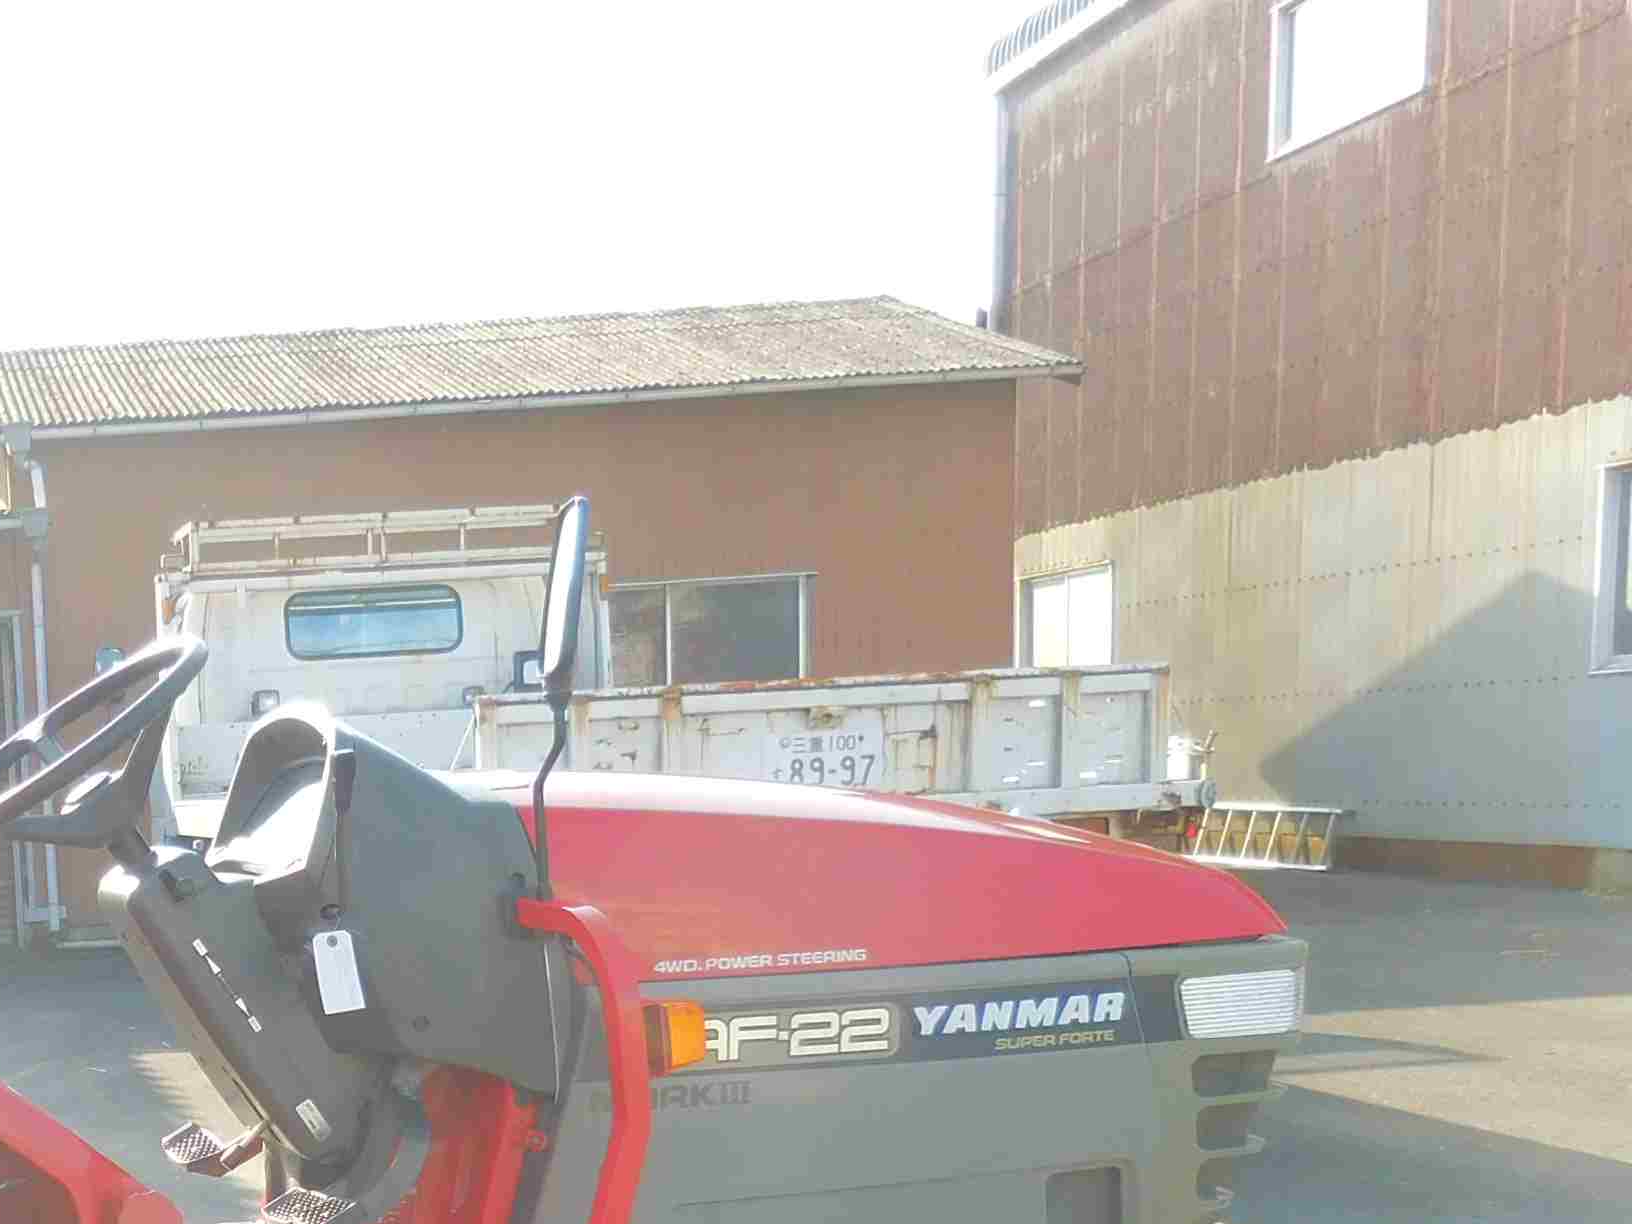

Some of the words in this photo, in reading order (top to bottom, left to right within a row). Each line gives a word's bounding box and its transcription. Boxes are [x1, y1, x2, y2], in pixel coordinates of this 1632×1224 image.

[789, 754, 876, 785] 89-97
[704, 954, 774, 972] POWER
[775, 947, 868, 968] STEERING
[913, 991, 1126, 1037] YANMAR
[994, 1033, 1057, 1051] SUPER
[1058, 1029, 1116, 1046] FORTE
